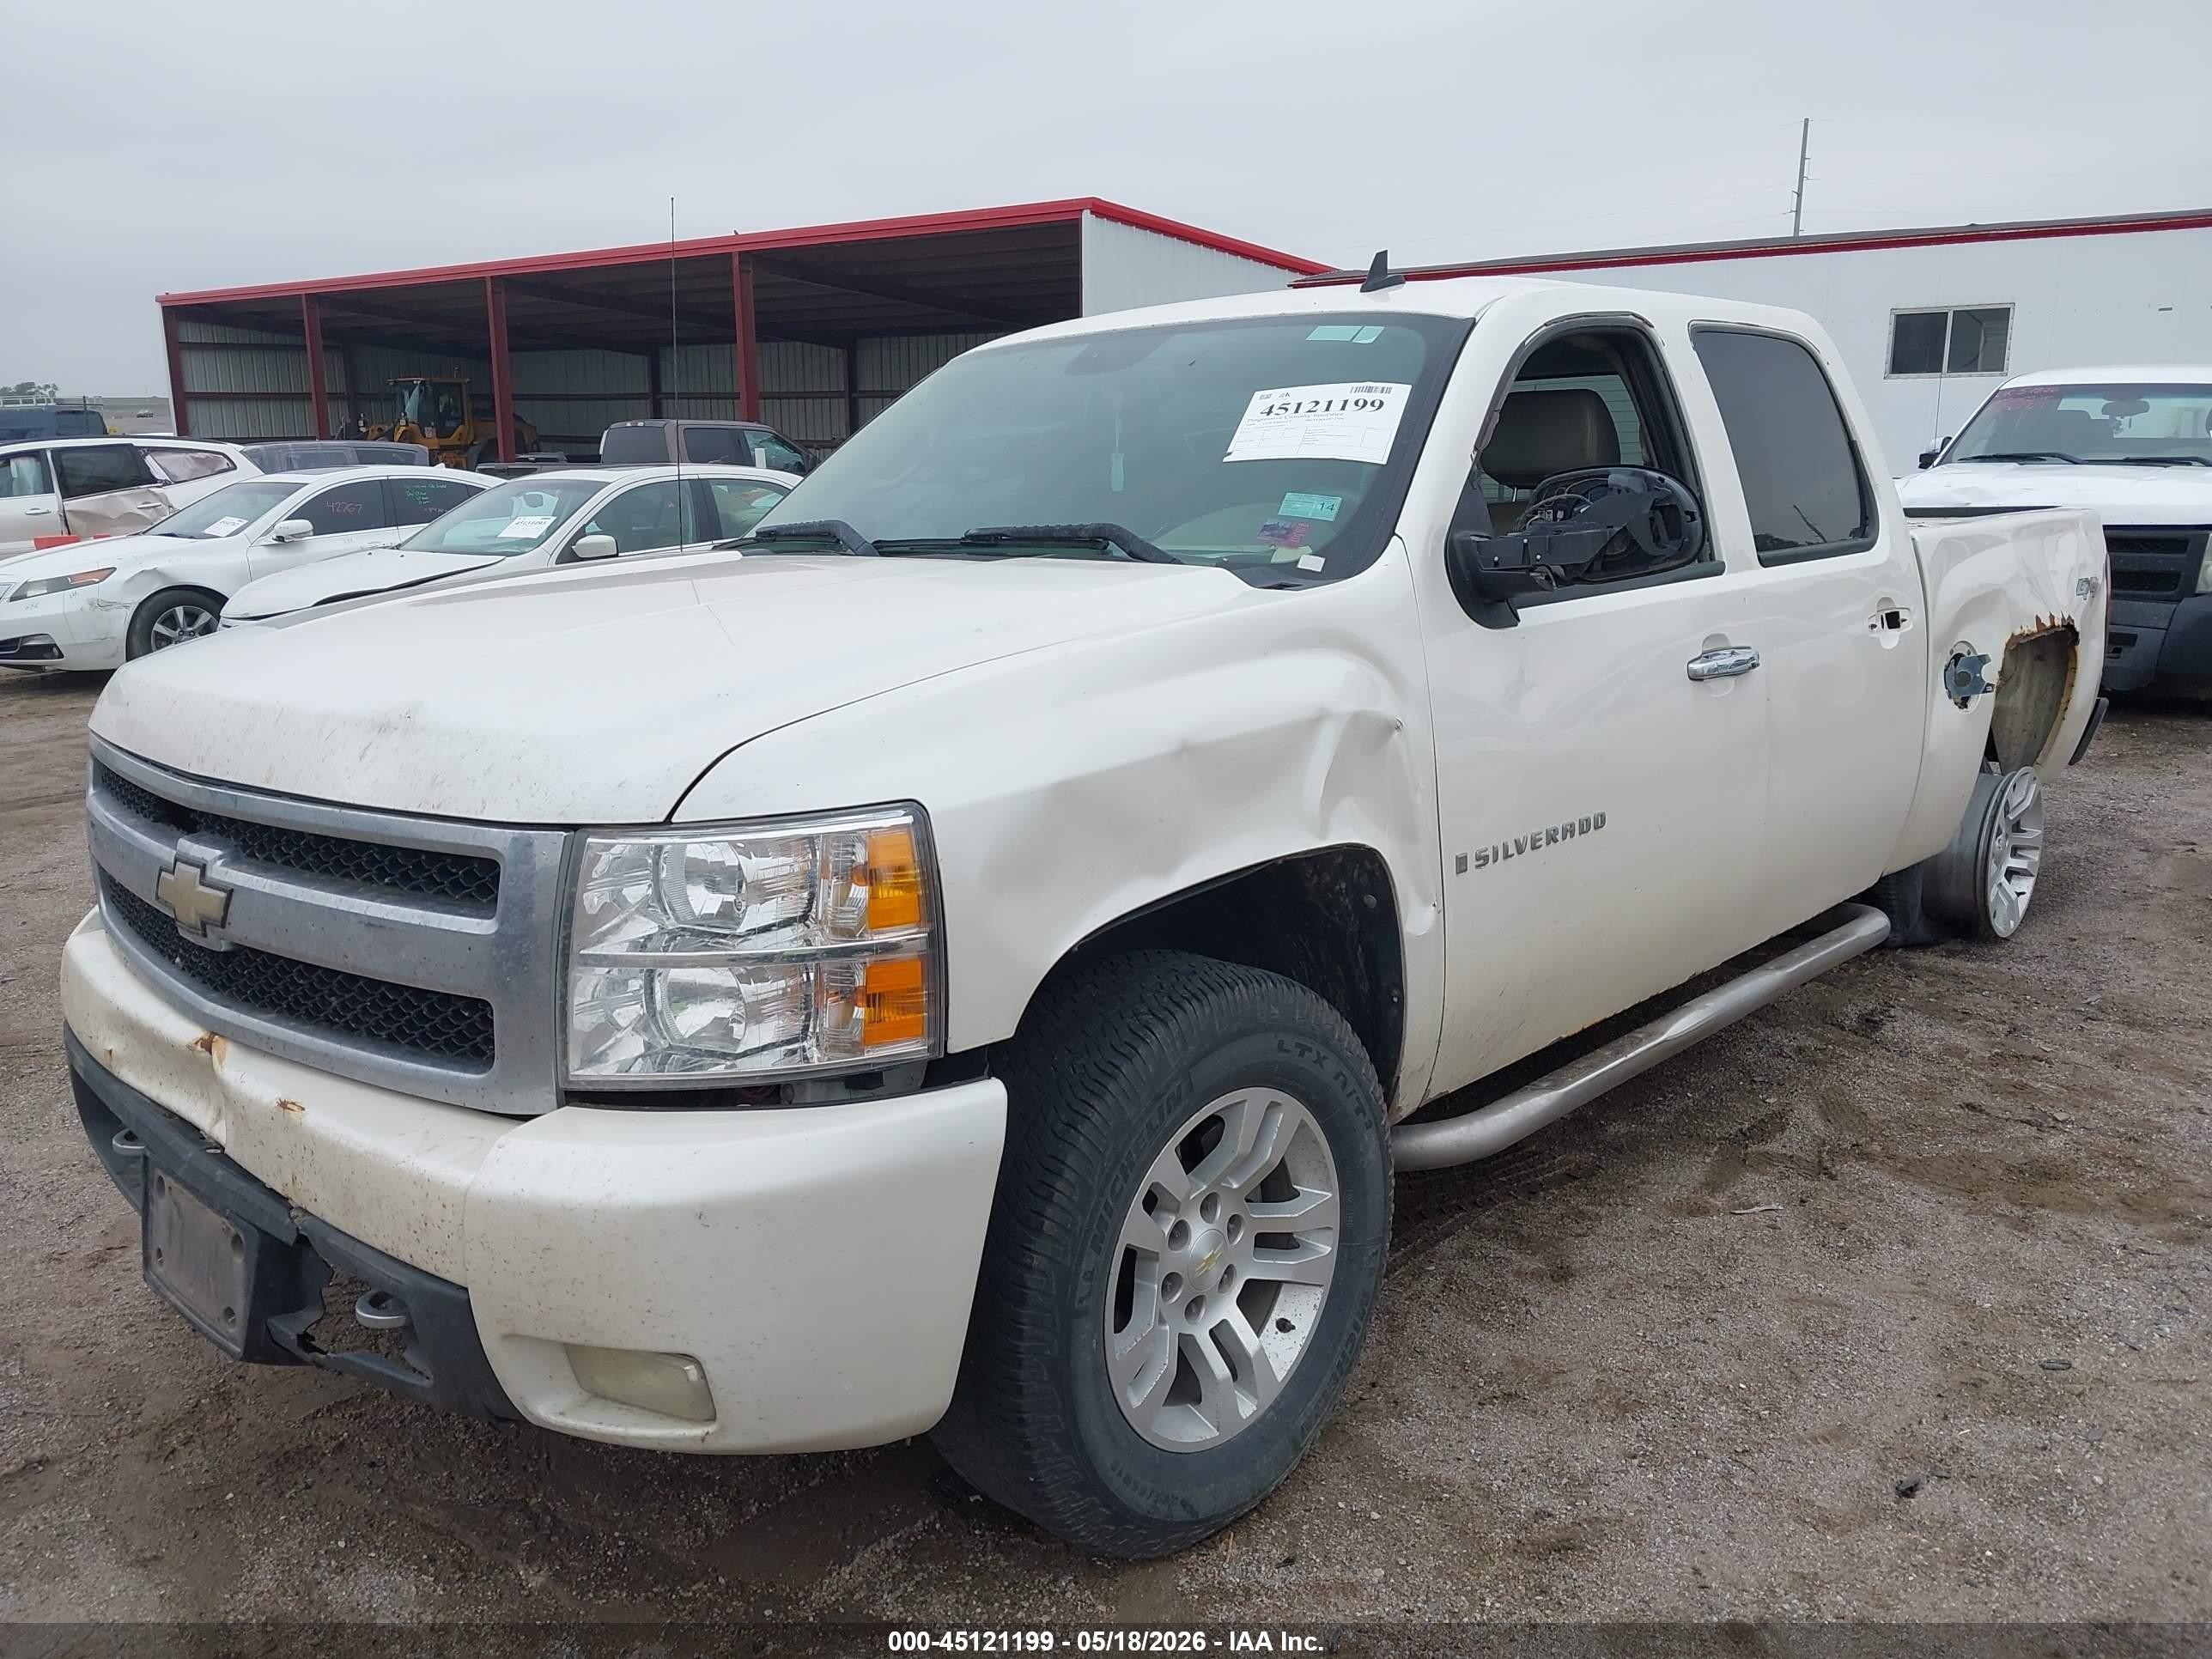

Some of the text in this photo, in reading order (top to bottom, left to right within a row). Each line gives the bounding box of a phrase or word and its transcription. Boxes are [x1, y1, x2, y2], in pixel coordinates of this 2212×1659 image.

[1260, 398, 1385, 416] 45121199
[326, 501, 363, 514] 42767
[1319, 501, 1335, 513] 14
[1474, 811, 1607, 869] SILVERADO
[1276, 1038, 1328, 1069] LTX
[1090, 1083, 1183, 1256] MICHELIN
